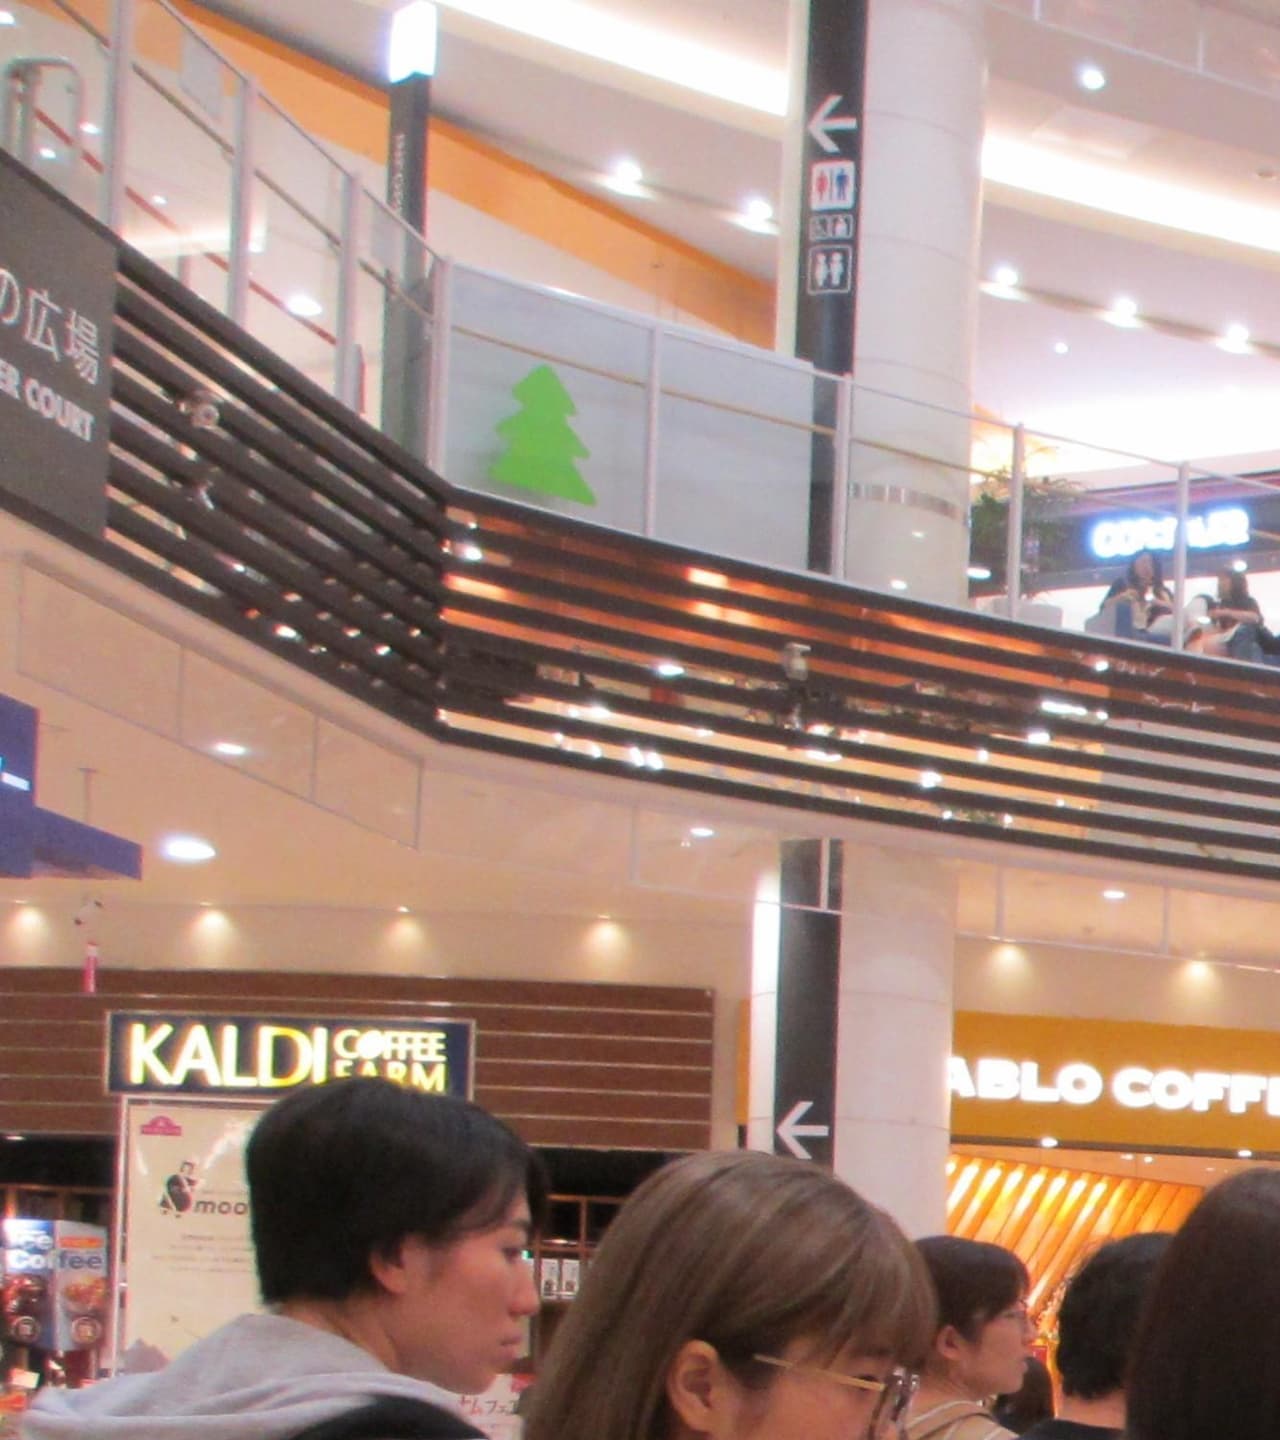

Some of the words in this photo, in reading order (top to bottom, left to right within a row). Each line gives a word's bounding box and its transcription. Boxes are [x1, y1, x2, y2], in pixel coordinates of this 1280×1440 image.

[25, 377, 96, 442] COURT
[127, 1023, 329, 1088] KALDI
[333, 1029, 447, 1062] COFFEE
[946, 1056, 1103, 1105] ABLO
